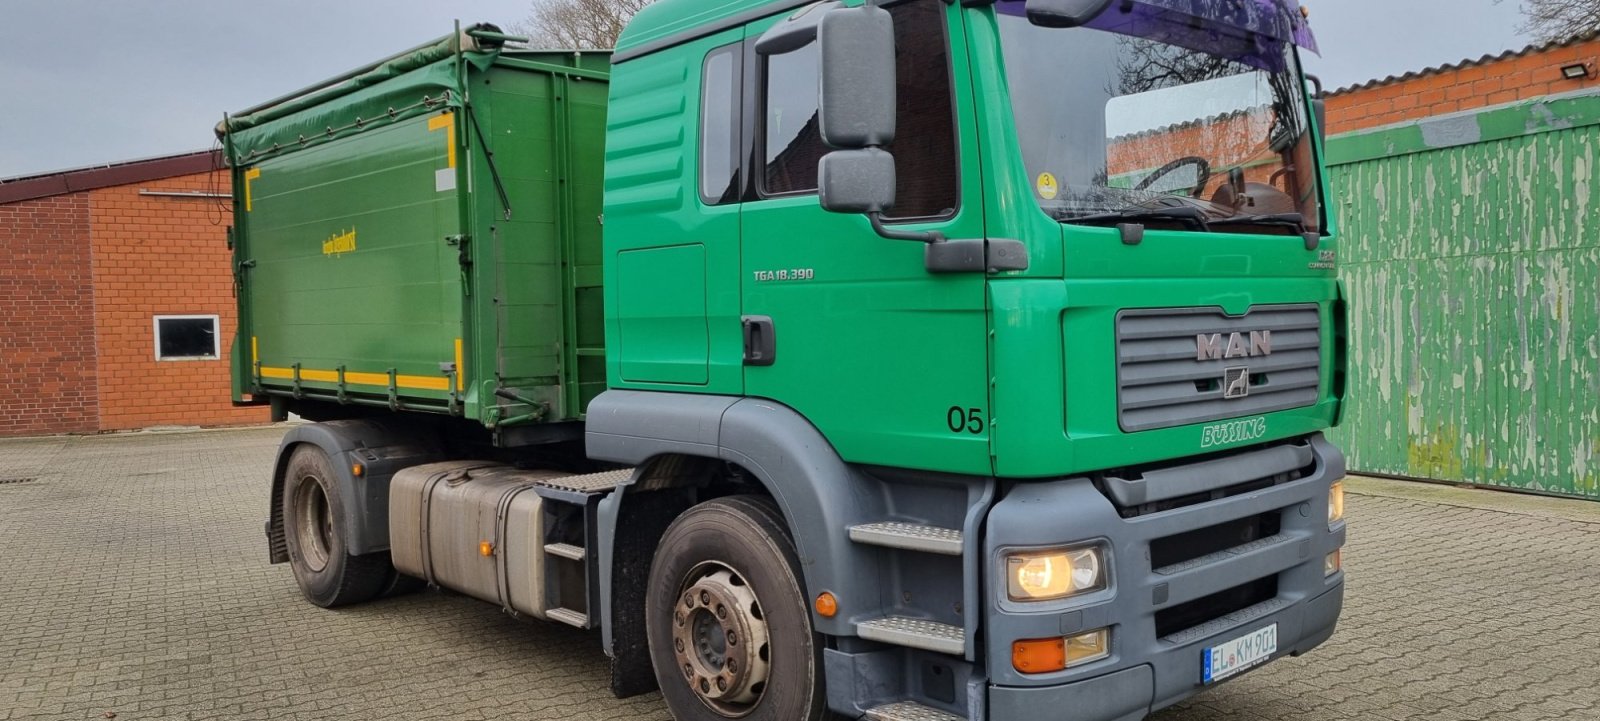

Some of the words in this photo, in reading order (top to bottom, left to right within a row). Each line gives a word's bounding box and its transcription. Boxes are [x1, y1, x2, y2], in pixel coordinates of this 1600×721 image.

[1043, 174, 1050, 186] 3
[1197, 330, 1271, 360] MAN
[947, 405, 984, 434] 05
[1201, 417, 1266, 447] BÜSSING
[1212, 647, 1229, 674] EL
[1236, 637, 1253, 664] KM
[1255, 628, 1276, 656] 901
